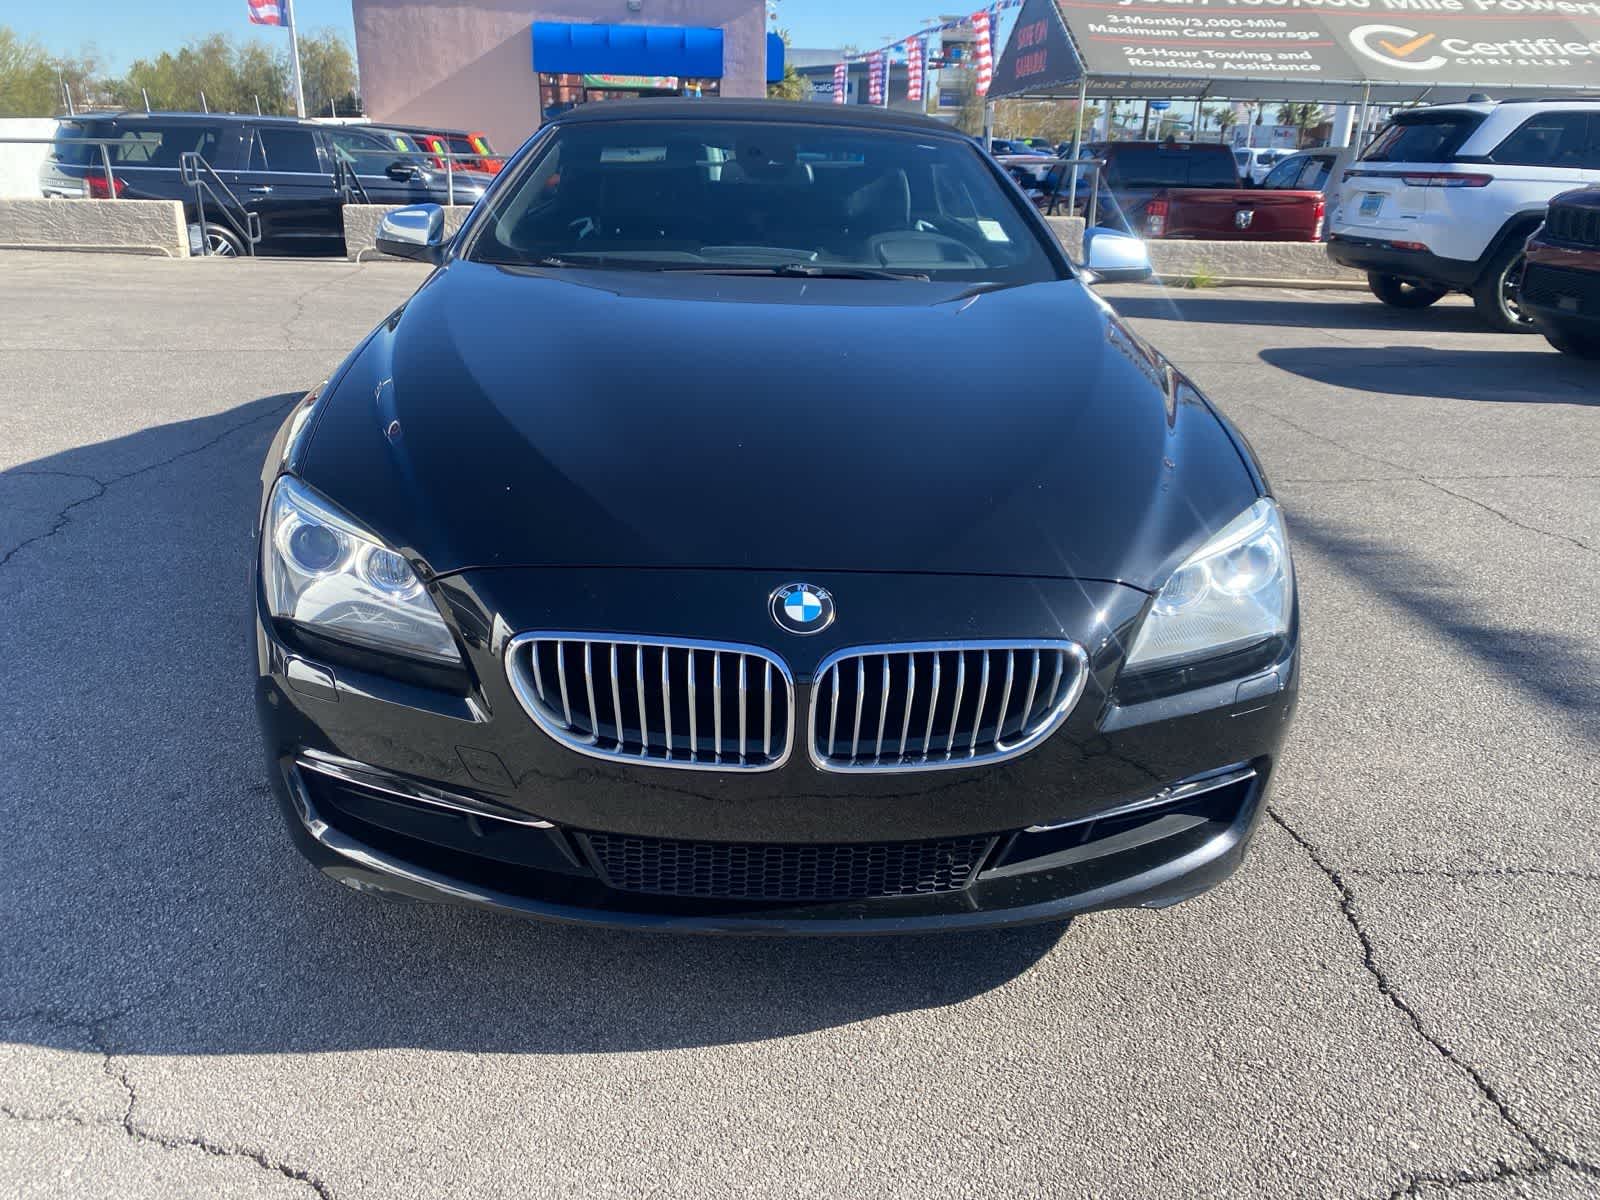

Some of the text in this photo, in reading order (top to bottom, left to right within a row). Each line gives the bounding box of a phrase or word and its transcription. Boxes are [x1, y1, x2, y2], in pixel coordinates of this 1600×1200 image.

[1106, 14, 1288, 28] 3-Month/3,000-Mile
[1088, 23, 1320, 40] Maximum Care Coverage
[1122, 46, 1313, 62] 24-Hour Towing and
[1456, 57, 1572, 65] CHRYSLER
[1128, 57, 1321, 72] Roadside Assistance
